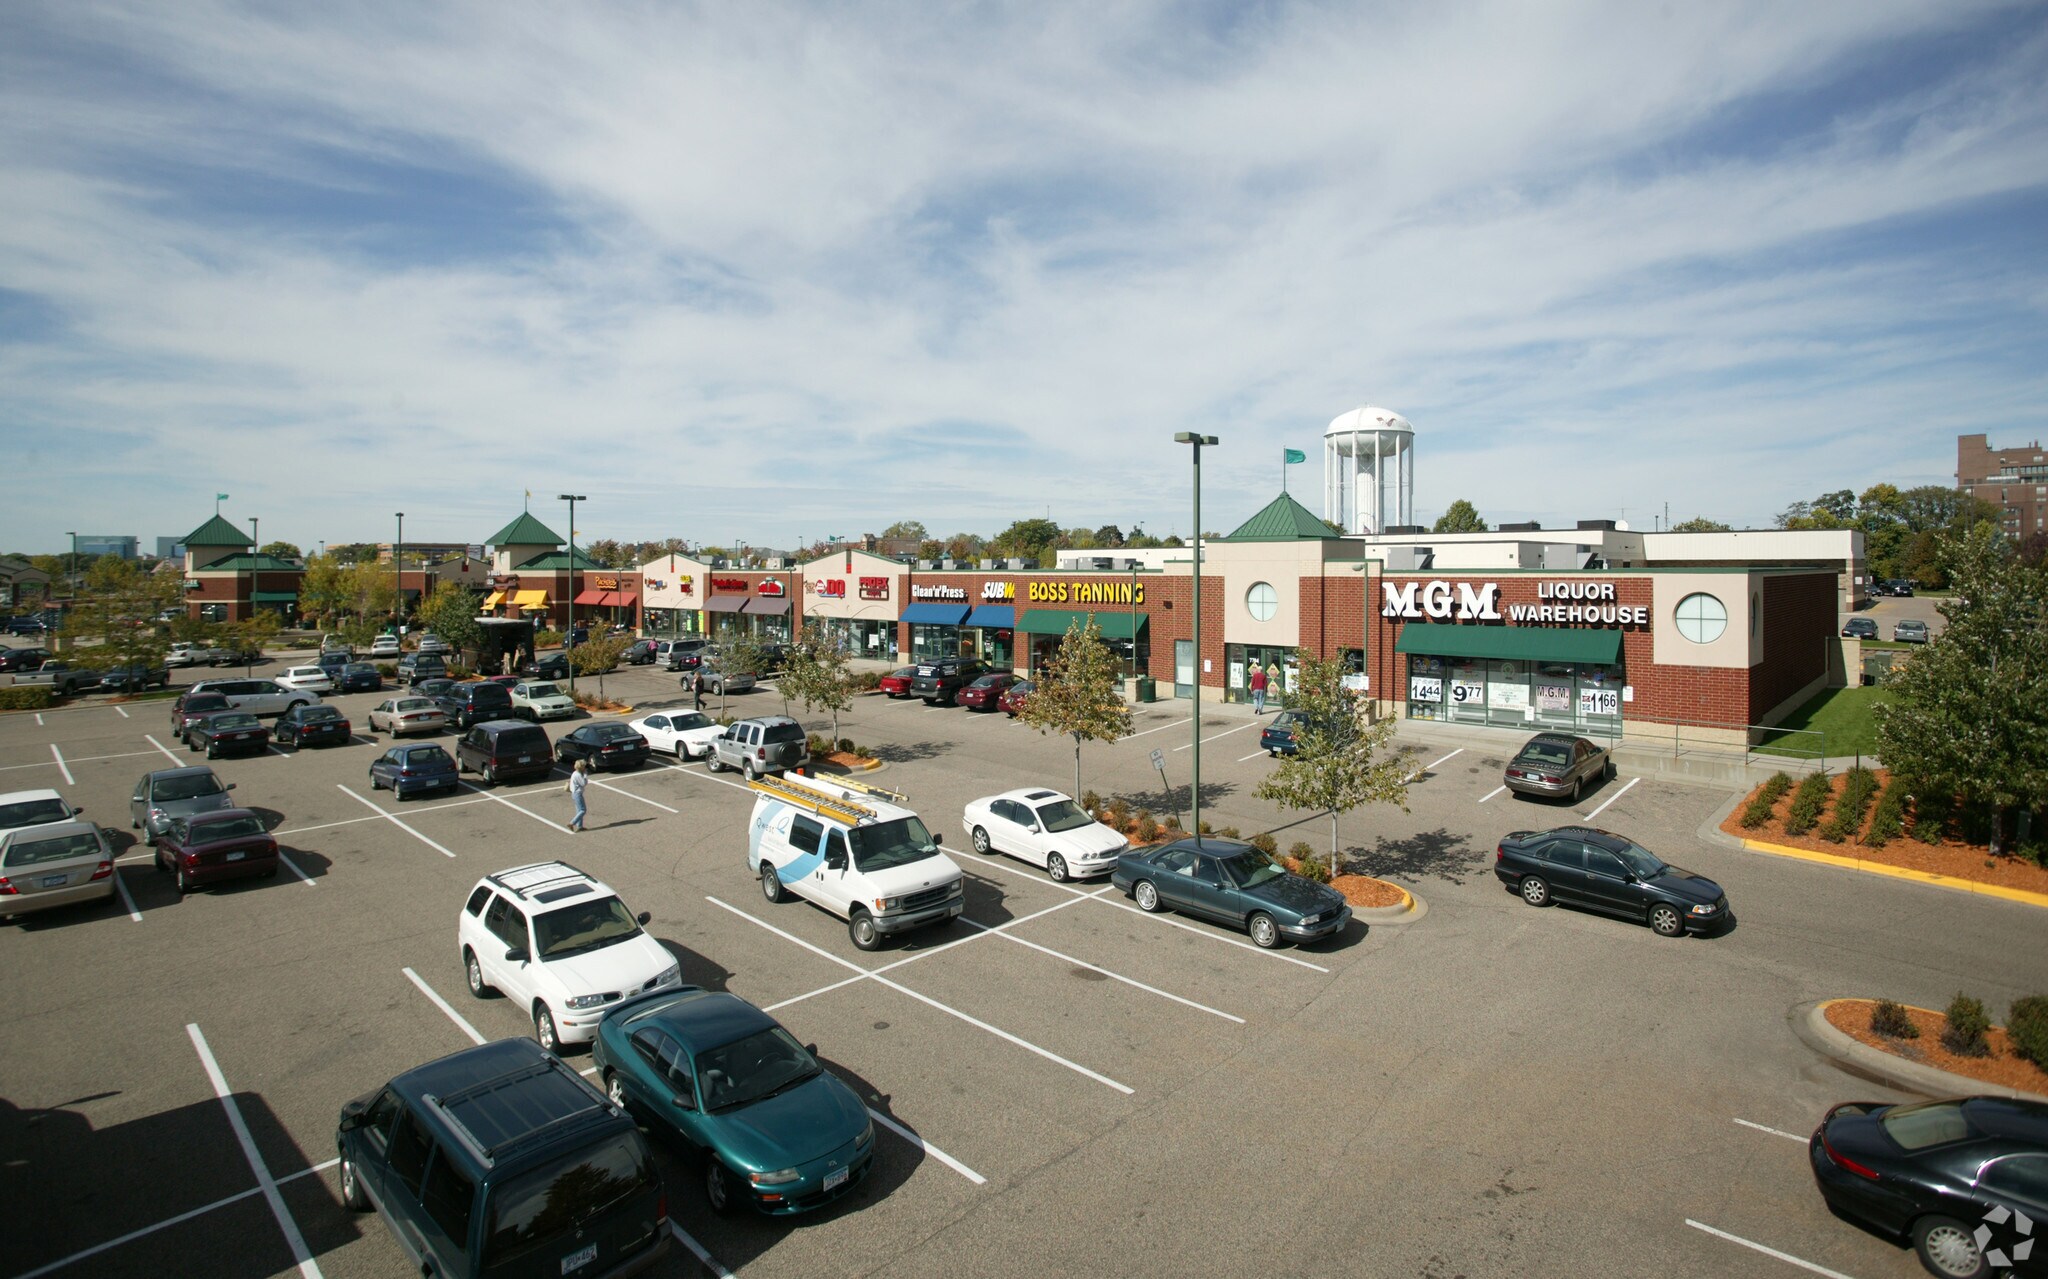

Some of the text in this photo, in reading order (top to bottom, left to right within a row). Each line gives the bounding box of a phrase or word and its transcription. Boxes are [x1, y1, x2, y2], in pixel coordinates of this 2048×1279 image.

[826, 579, 845, 598] DQ
[1029, 582, 1144, 603] BOSS TANNING
[1538, 582, 1614, 600] LIQUOR
[1509, 605, 1647, 624] WAREHOUSE
